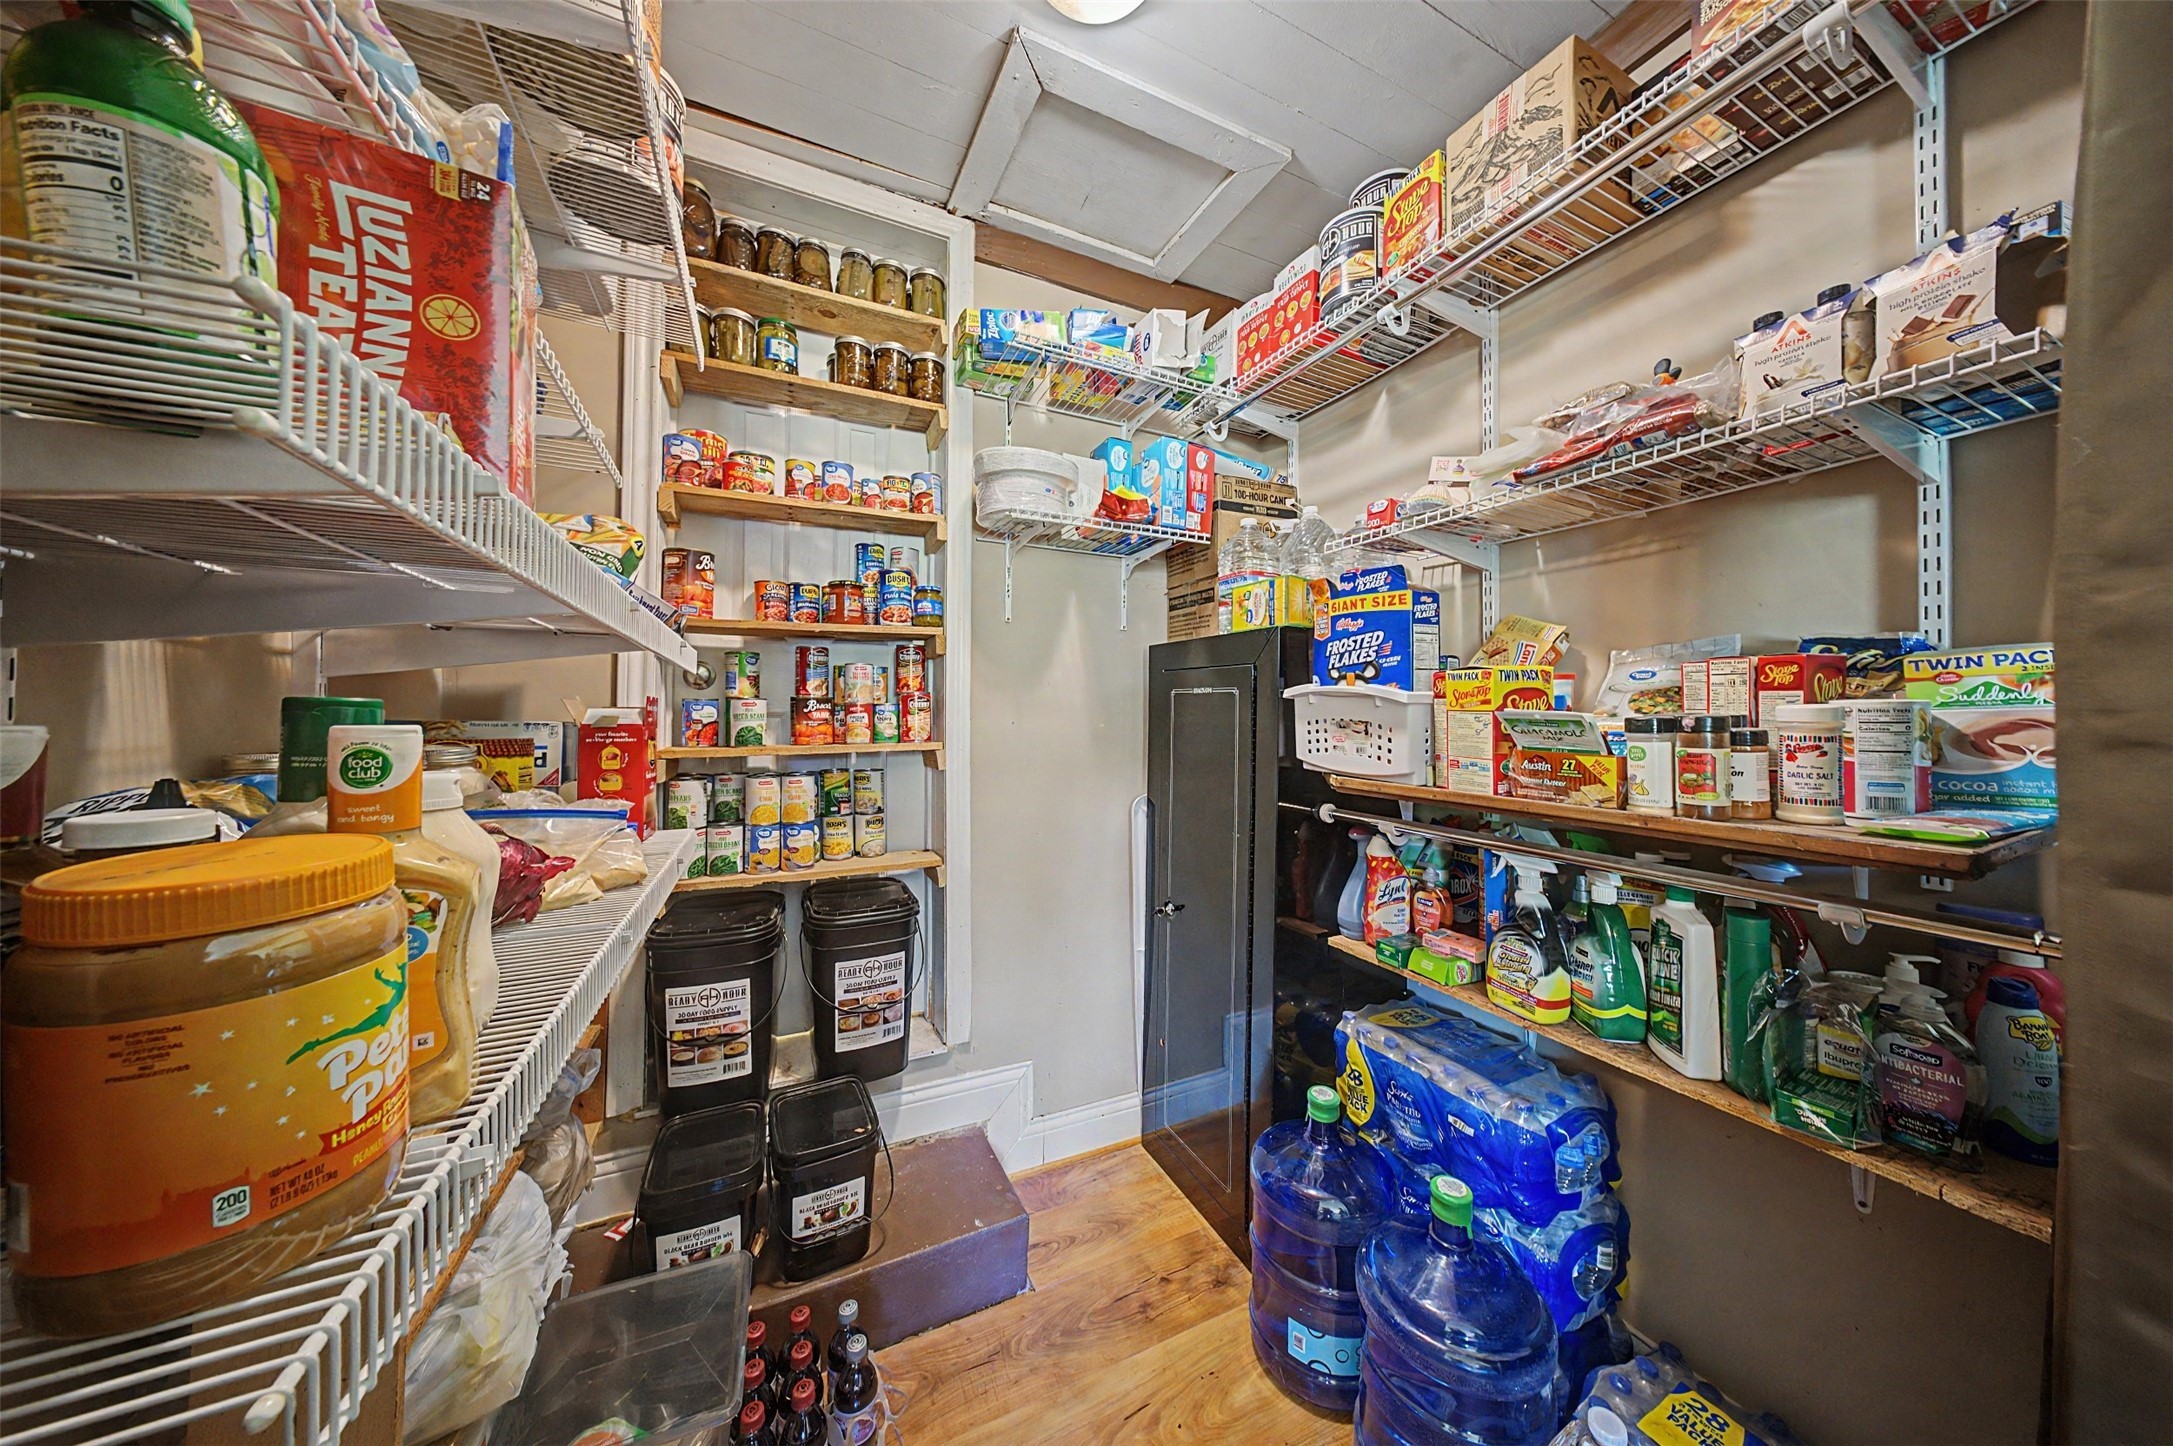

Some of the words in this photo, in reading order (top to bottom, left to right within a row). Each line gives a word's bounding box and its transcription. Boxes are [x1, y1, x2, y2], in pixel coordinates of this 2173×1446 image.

[71, 121, 120, 142] Facts
[110, 176, 124, 192] 0
[329, 179, 413, 393] LUZIANN
[1911, 268, 1962, 294] ATKINS
[987, 310, 1000, 340] Ziploc
[1771, 333, 1812, 353] ATKINS
[1234, 492, 1268, 503] 100-HOUR
[1355, 571, 1388, 587] FROSTED
[1331, 598, 1367, 614] GIANT
[1371, 593, 1408, 609] SIZE
[1326, 630, 1384, 657] FROSTED
[1328, 646, 1378, 670] FLAKES
[1908, 655, 1984, 673] TWIN
[1447, 672, 1463, 681] TWIN
[1463, 672, 1479, 681] PACK
[1499, 670, 1519, 682] TWIN
[1521, 669, 1541, 682] PACK
[1760, 664, 1799, 682] Stove
[2030, 663, 2055, 672] INSI
[1773, 674, 1794, 687] Top
[1814, 673, 1844, 704] Stove
[1506, 695, 1549, 711] Stove
[1936, 683, 2047, 706] Suddenly
[1511, 725, 1588, 738] GUACAMOLE
[347, 756, 382, 768] food
[1521, 759, 1552, 772] Austin
[1562, 759, 1577, 770] 27
[1593, 758, 1611, 775] VALUE
[348, 767, 381, 779] club
[1787, 771, 1814, 780] GARLIC
[1816, 771, 1834, 780] SALT
[1938, 780, 1998, 792] cocoa
[2002, 779, 2047, 788] instant
[2003, 786, 2040, 794] cocoa
[1953, 794, 1991, 803] added
[346, 804, 381, 814] sweet
[337, 815, 356, 823] and
[361, 813, 395, 824] tangy
[837, 967, 861, 979] READY
[883, 959, 903, 971] HOUR
[668, 995, 697, 1007] READY
[722, 988, 747, 1000] HOUR
[1823, 1051, 1861, 1070] Ibupro
[1881, 1055, 1965, 1087] NTIBACTERIAL
[332, 1110, 382, 1149] Honey
[216, 1188, 247, 1212] 200
[1683, 1397, 1730, 1433] 28
